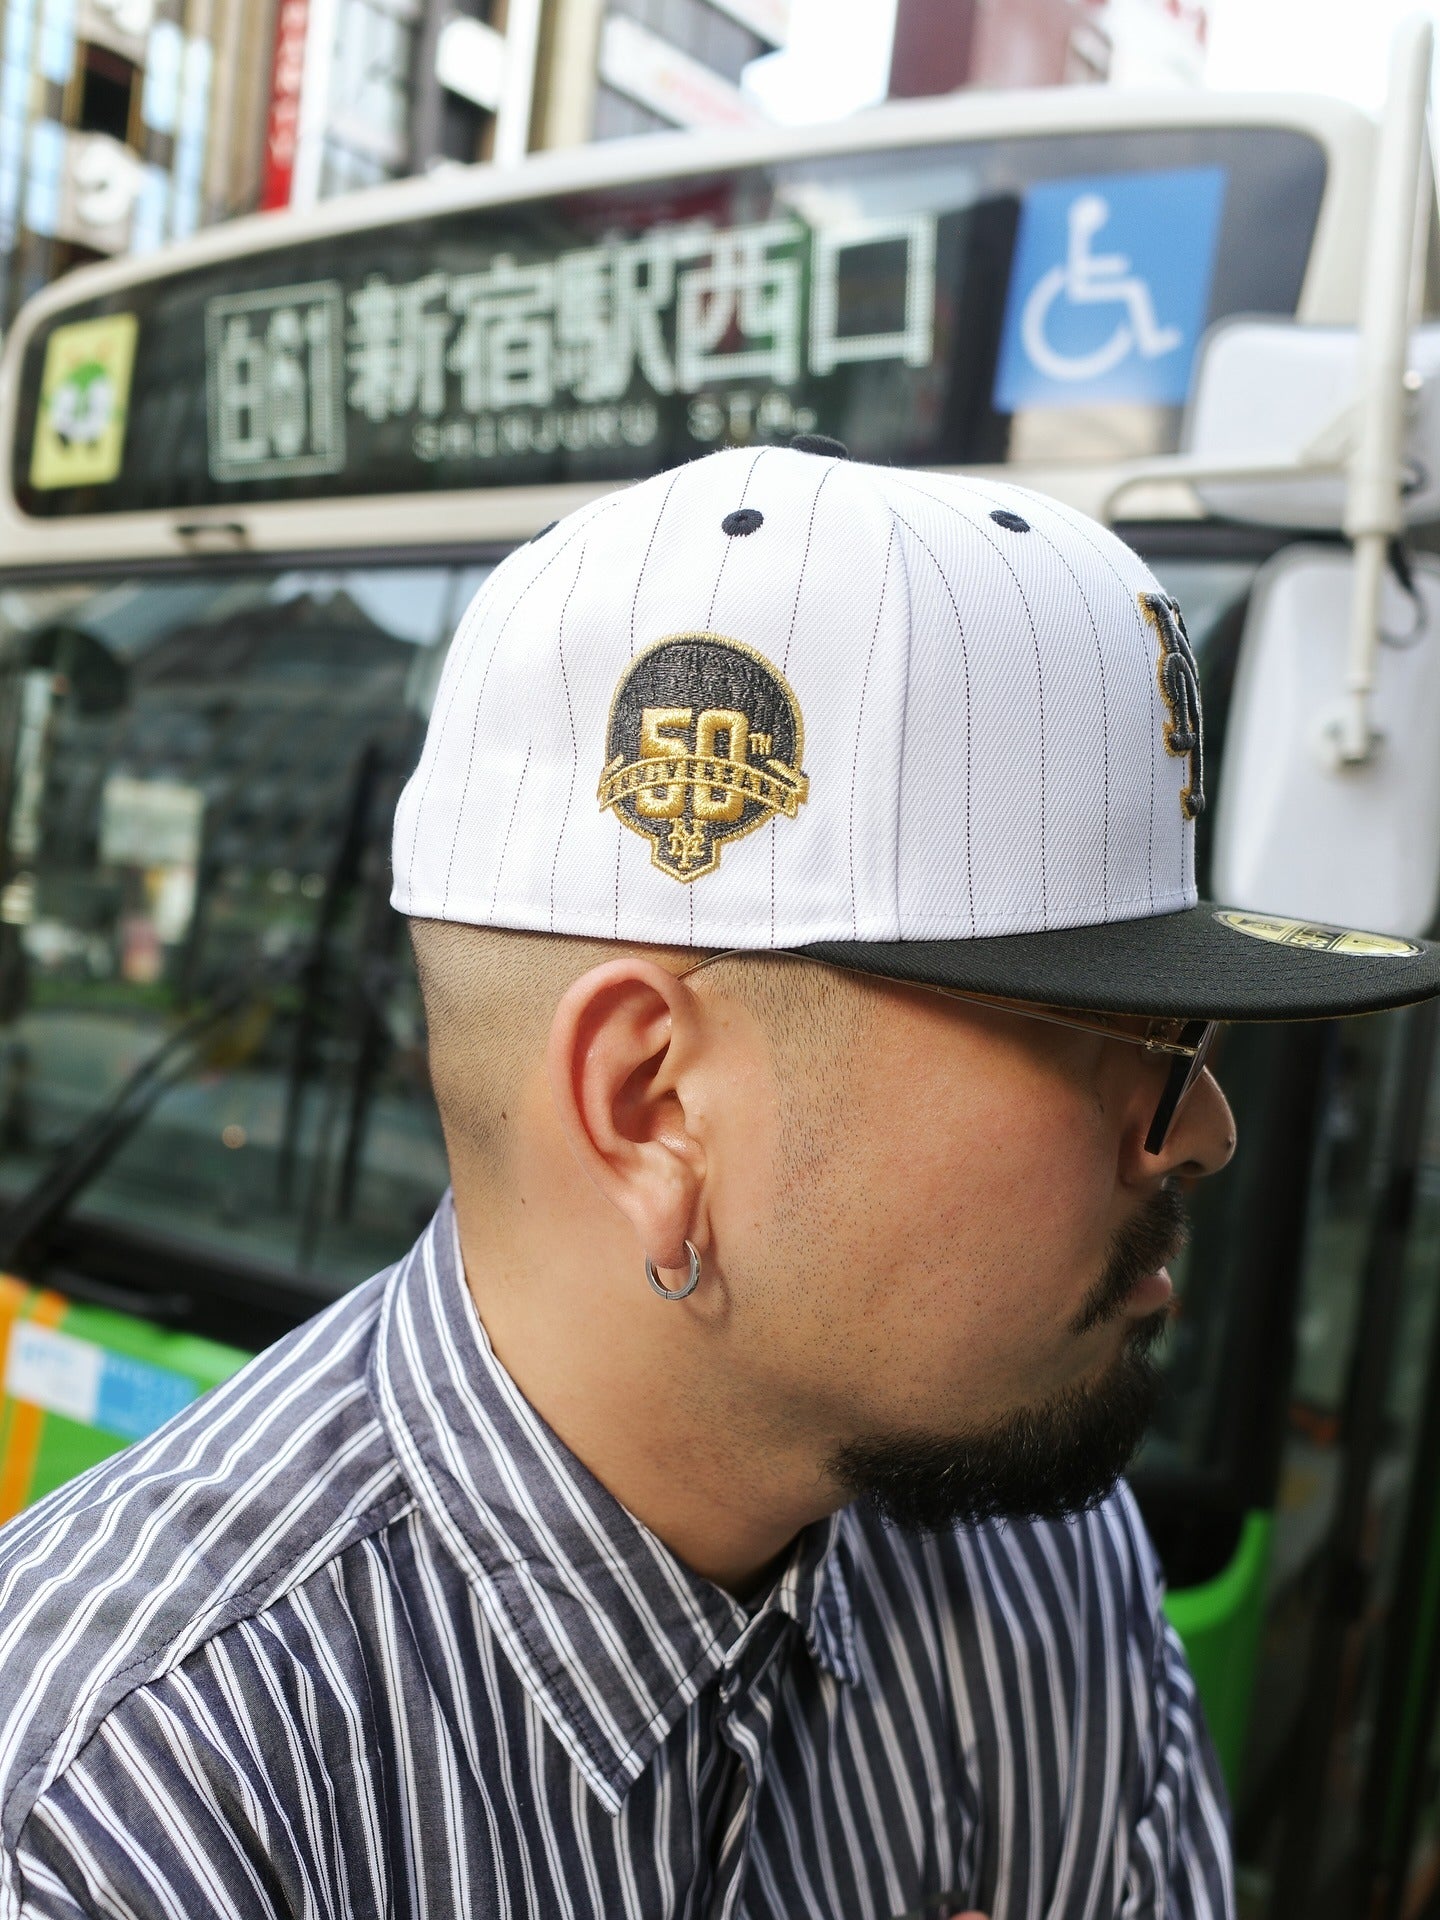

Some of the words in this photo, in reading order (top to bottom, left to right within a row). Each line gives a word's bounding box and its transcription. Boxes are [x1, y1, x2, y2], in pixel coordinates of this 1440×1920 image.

[346, 213, 936, 422] 新宿駅西口
